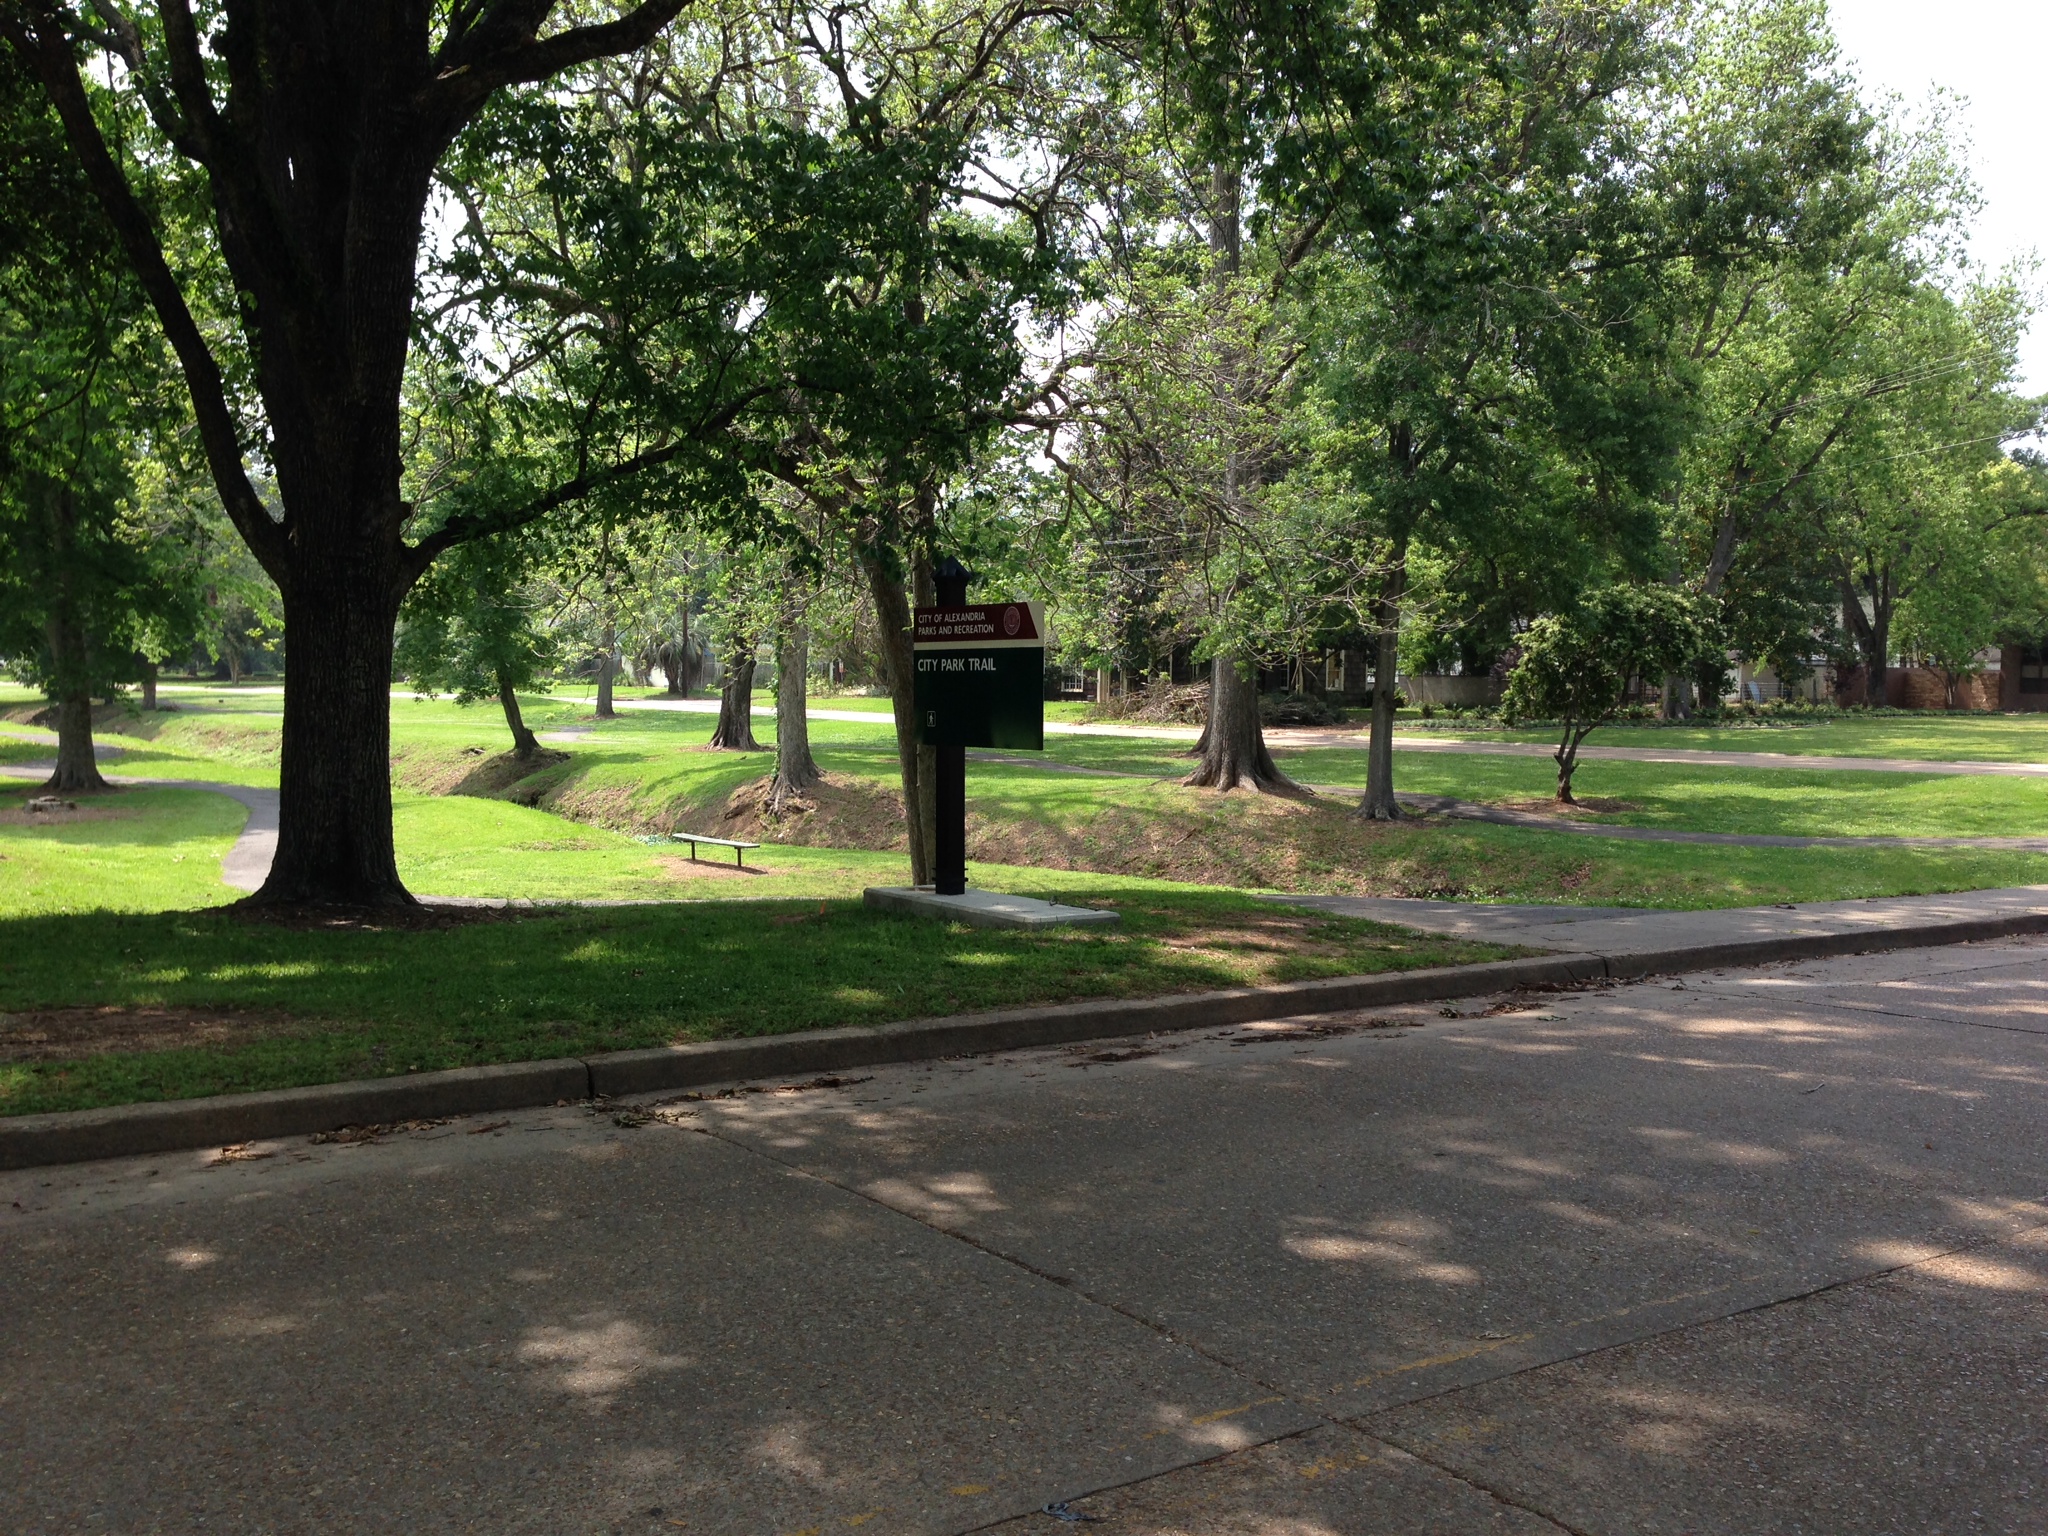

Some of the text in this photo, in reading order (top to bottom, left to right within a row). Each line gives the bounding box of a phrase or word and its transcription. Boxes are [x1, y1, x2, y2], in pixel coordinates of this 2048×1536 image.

[918, 612, 986, 624] CITY OF ALEXANDRIA
[918, 624, 994, 636] PARKS AND RECREATION
[918, 658, 996, 671] CITY PARK TRAIL
